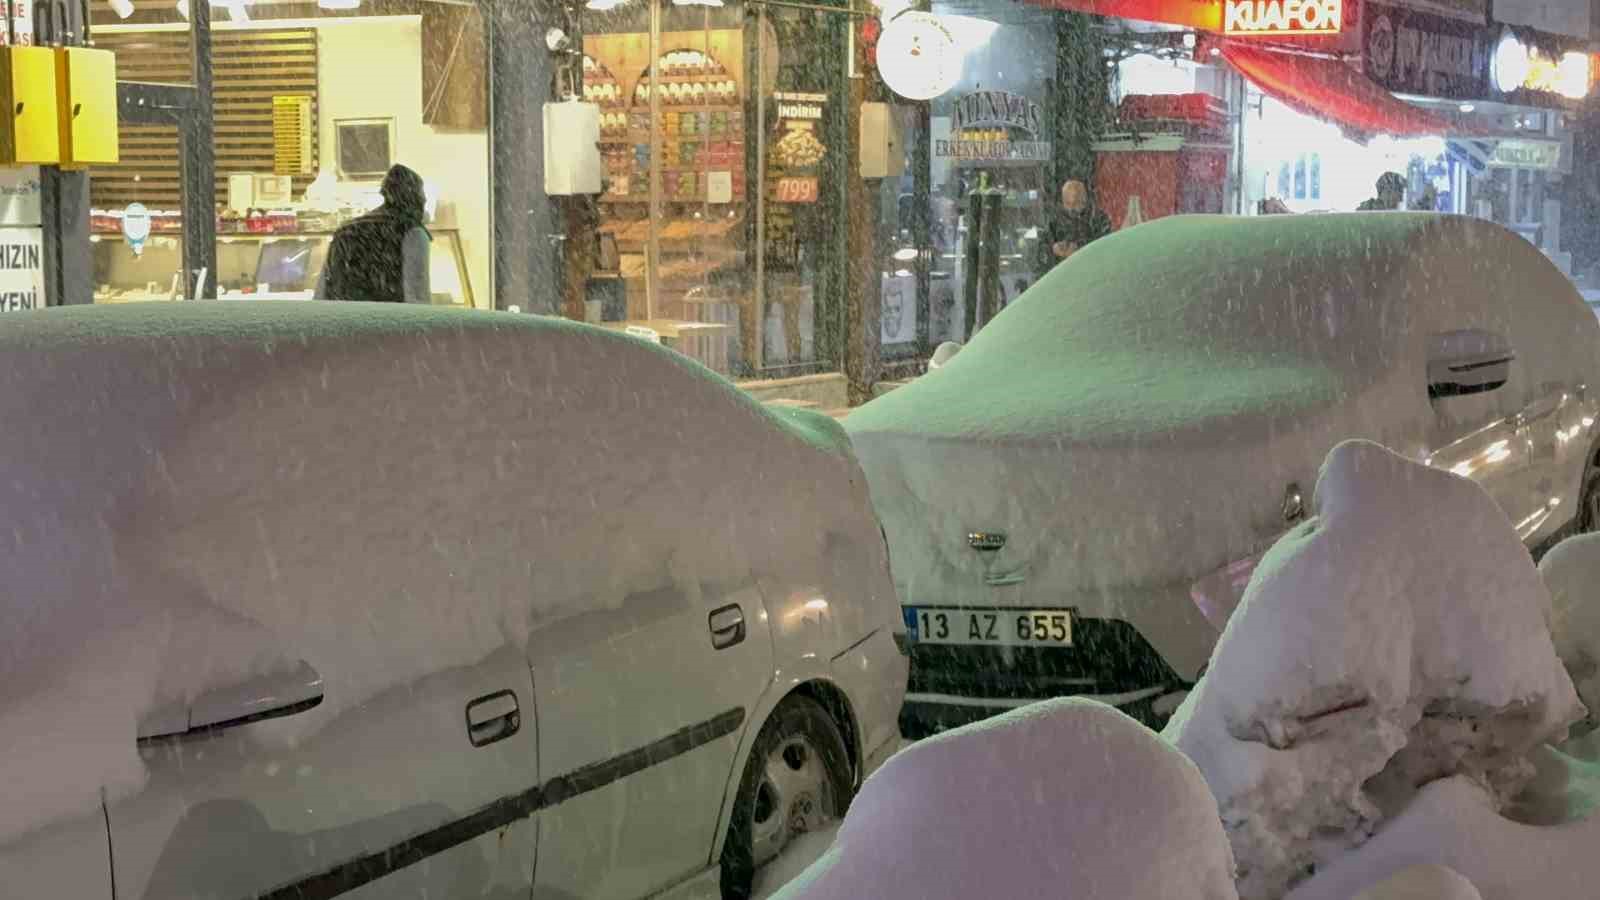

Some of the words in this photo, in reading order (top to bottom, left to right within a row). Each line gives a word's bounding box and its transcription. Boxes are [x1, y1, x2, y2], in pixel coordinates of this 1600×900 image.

[921, 613, 949, 639] 13
[968, 614, 999, 640] AZ
[1016, 615, 1066, 641] 655
